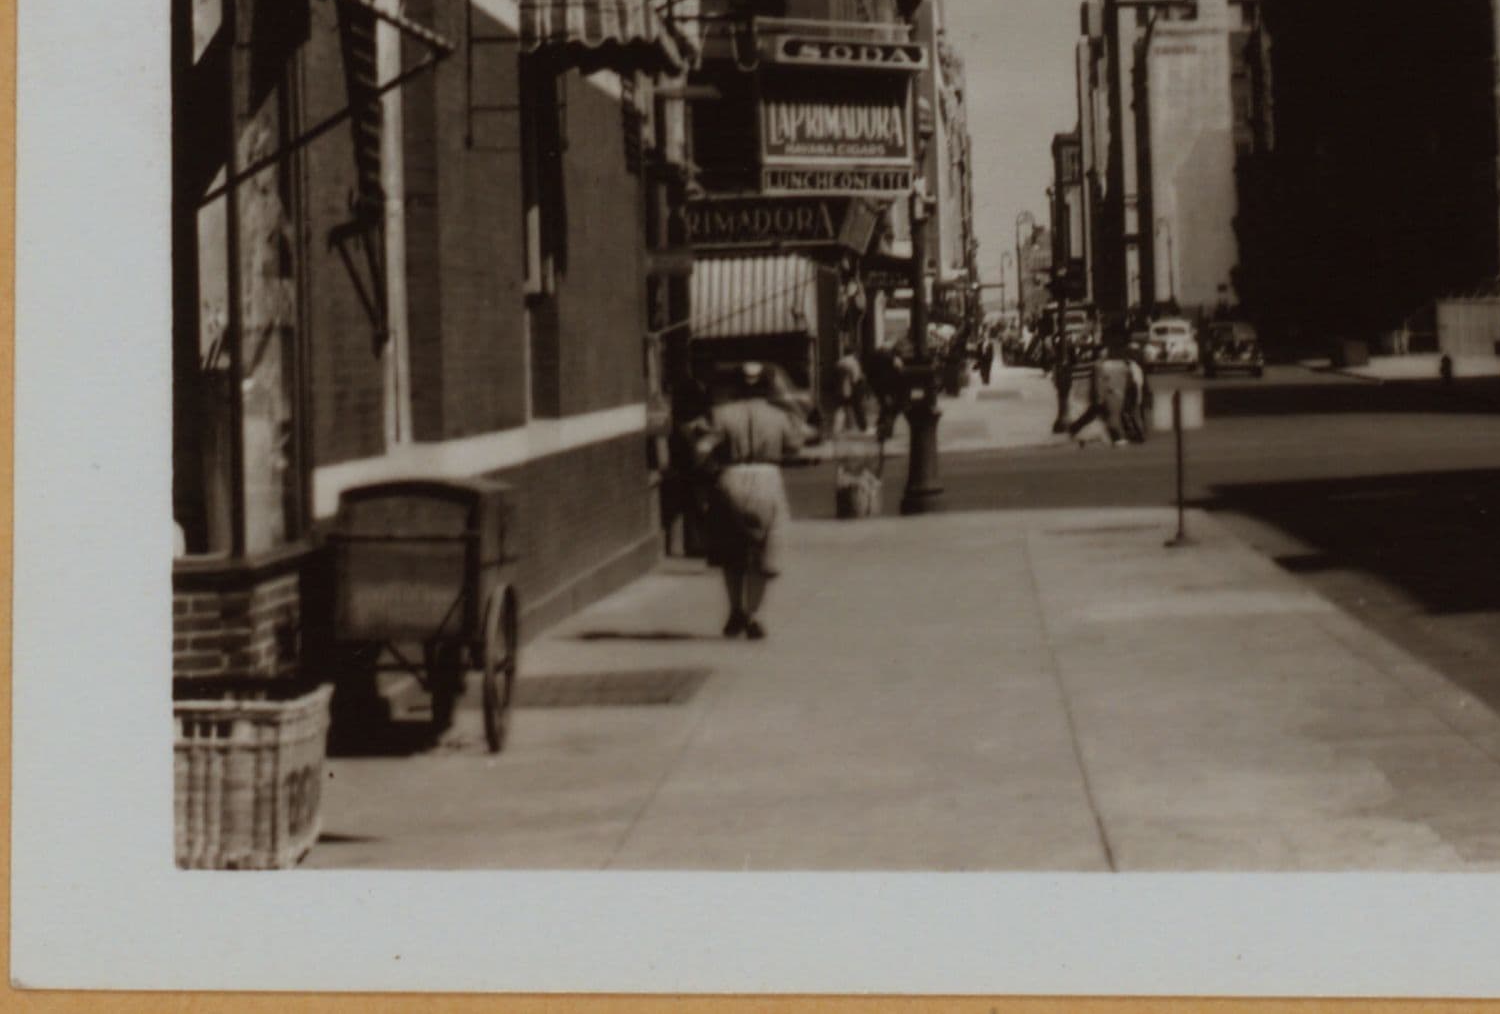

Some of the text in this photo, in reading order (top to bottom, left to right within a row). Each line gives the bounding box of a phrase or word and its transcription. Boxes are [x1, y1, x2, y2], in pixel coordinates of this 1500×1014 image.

[800, 45, 912, 63] SODA
[836, 144, 886, 156] CIGARS
[686, 202, 835, 239] RIMADORA
